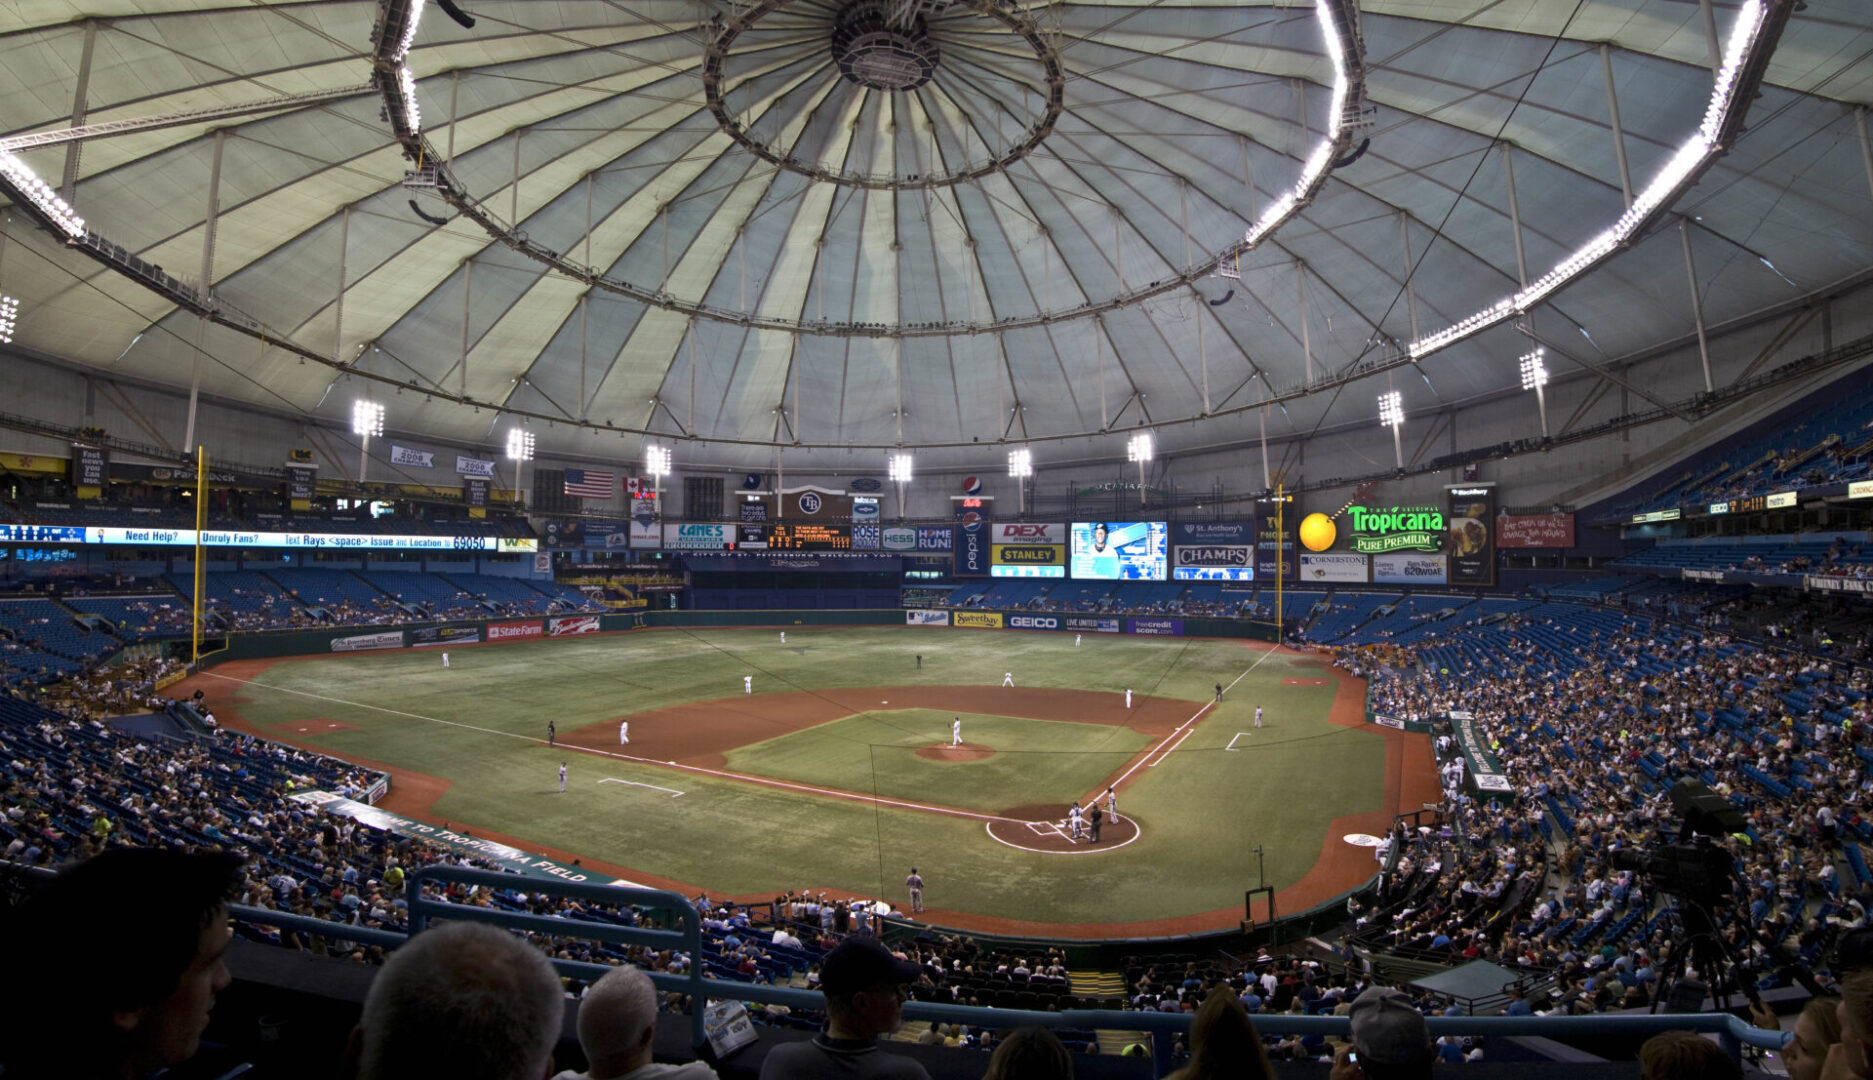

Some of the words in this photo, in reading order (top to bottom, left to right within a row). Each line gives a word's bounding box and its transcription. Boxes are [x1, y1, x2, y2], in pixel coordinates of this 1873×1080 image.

[401, 453, 423, 461] 2008
[465, 462, 486, 471] 2008
[804, 496, 818, 510] TB
[1348, 506, 1443, 534] Tropicana
[854, 526, 879, 538] ROSE
[1003, 525, 1048, 537] DEX
[1207, 524, 1243, 534] Anthony's
[126, 530, 149, 541] Need
[153, 531, 178, 543] Help?
[202, 532, 231, 544] Unruly
[234, 533, 259, 544] Fans?
[285, 534, 300, 545] Text
[304, 535, 325, 548] Rays
[370, 537, 394, 546] Issue
[396, 539, 408, 547] and
[410, 537, 442, 547] Location
[444, 539, 451, 547] to
[453, 537, 486, 550] 69050
[885, 534, 914, 543] HESS
[919, 539, 952, 548] RUN!
[1358, 539, 1383, 550] PURE
[1384, 535, 1430, 549] PREMIUM
[967, 534, 979, 570] pepsi
[1005, 550, 1052, 560] STANLEY
[1181, 549, 1246, 564] CHAMPS
[1310, 556, 1368, 566] CORNERSTONE
[958, 613, 999, 627] Sweetbay
[1011, 616, 1057, 628] GEICO
[1066, 619, 1078, 627] LIVE
[1078, 619, 1098, 627] UNITED
[336, 801, 414, 828] WEOME
[412, 824, 435, 833] TO
[532, 860, 588, 883] FIELD
